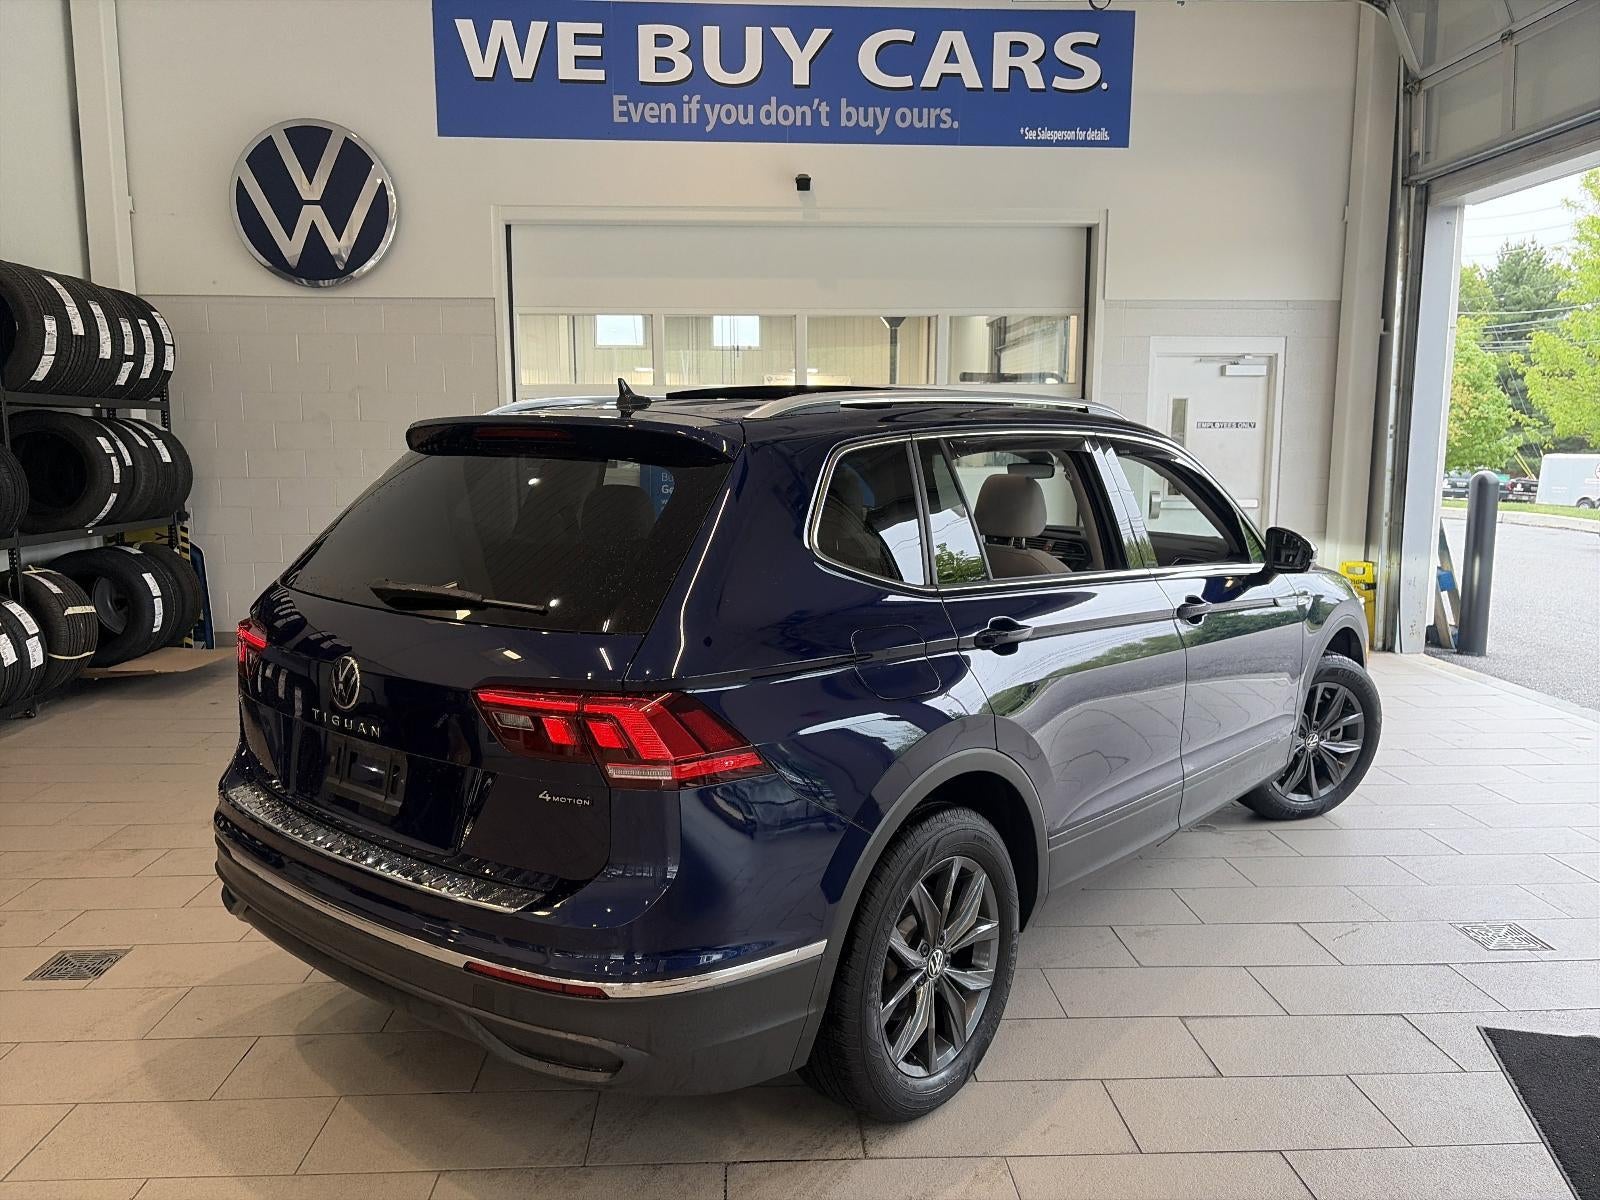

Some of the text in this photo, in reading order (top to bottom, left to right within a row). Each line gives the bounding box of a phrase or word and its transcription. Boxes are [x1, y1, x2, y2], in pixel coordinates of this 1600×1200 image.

[454, 19, 1108, 92] WE BUY CARS.
[612, 94, 959, 136] Even if you don't buy ours.
[1037, 127, 1076, 143] Salesperson
[1076, 127, 1087, 140] for
[1086, 127, 1110, 141] details.
[311, 707, 381, 739] TIGUAN
[538, 790, 590, 806] 4MOTION
